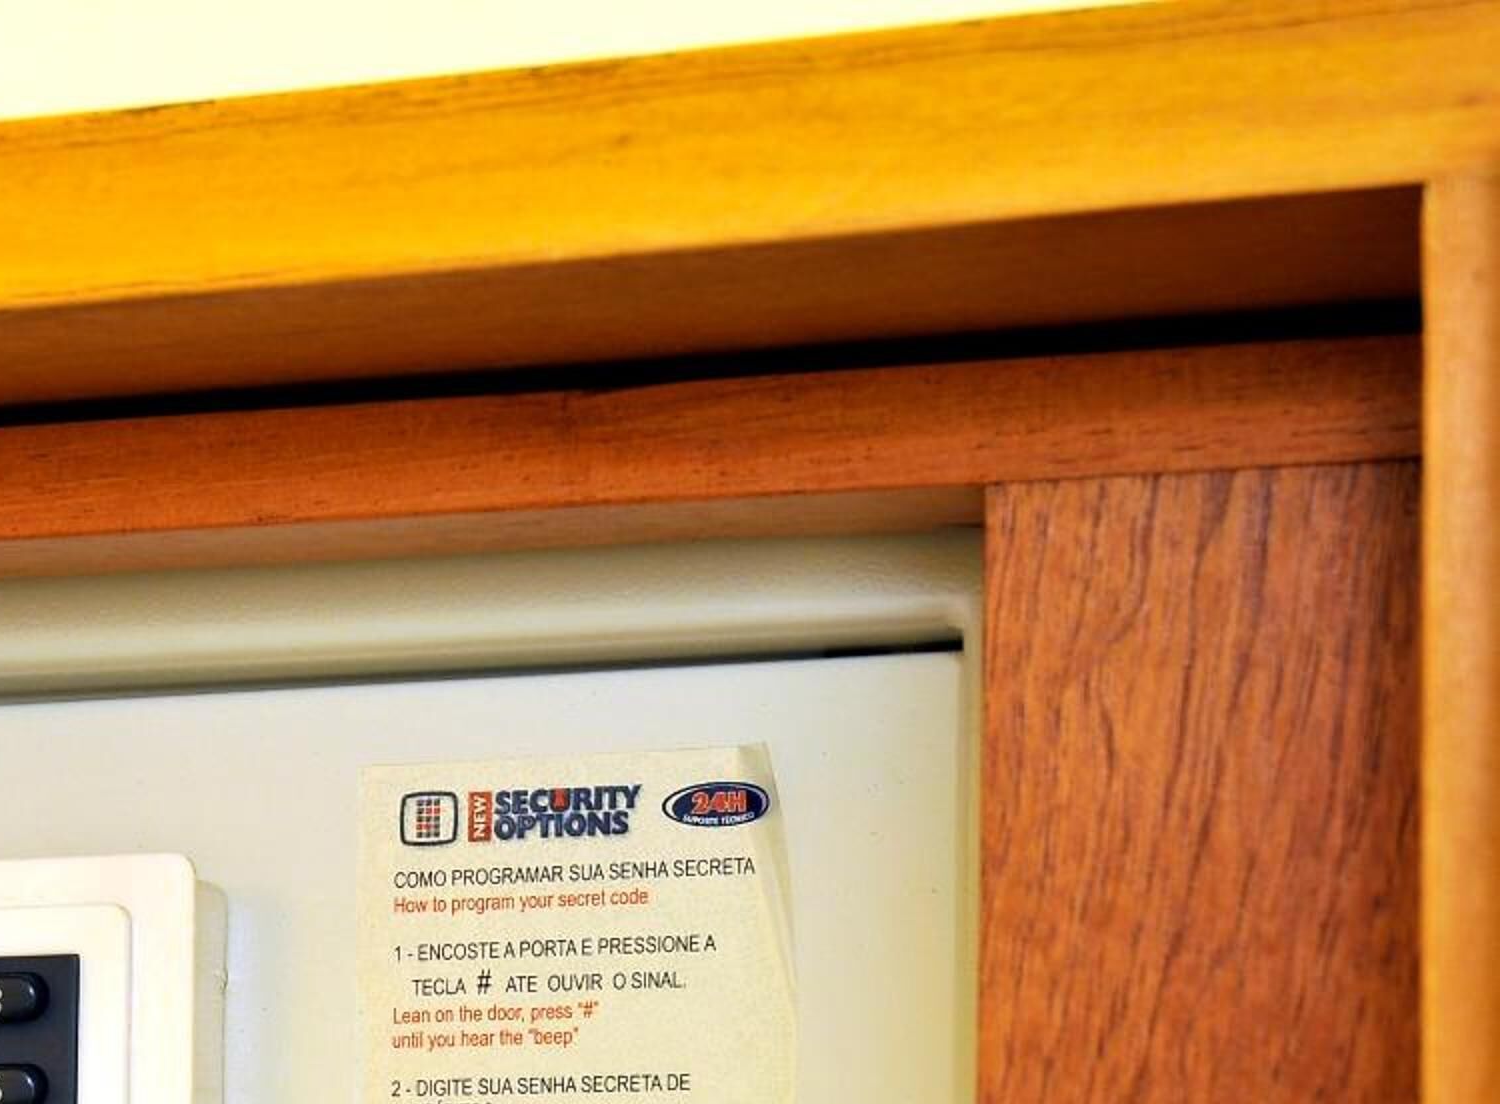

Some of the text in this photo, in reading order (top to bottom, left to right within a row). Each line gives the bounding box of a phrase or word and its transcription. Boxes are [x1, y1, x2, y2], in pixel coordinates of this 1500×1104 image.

[494, 784, 642, 816] SECURITY
[691, 790, 746, 814] 24H
[474, 792, 490, 840] NEW
[493, 812, 629, 840] OPTIONS
[394, 857, 755, 889] COMO PROGRAMAR SUA SENHA SECRETA
[394, 888, 649, 915] How to program your secret code
[394, 946, 400, 961] 1
[418, 942, 500, 960] ENCOSTE
[504, 941, 515, 958] A
[519, 940, 578, 958] PORTA
[581, 939, 591, 956] E
[598, 936, 701, 955] PRESSIONE
[704, 935, 716, 953] A
[412, 969, 686, 996] TECLA # ATE OUVIR O SINAL.
[393, 1005, 431, 1025] Lean
[435, 1007, 454, 1023] on
[459, 1004, 483, 1022] the
[487, 1003, 525, 1024] door,
[530, 1004, 573, 1023] press
[392, 1030, 423, 1049] until
[427, 1031, 455, 1050] you
[460, 1028, 494, 1046] hear
[499, 1026, 523, 1044] the
[391, 1080, 401, 1097] 2
[416, 1078, 473, 1097] DIGITE
[478, 1078, 513, 1096] SUA
[517, 1076, 577, 1095] SENHA
[581, 1074, 663, 1094] SECRETA
[667, 1073, 691, 1091] DE
